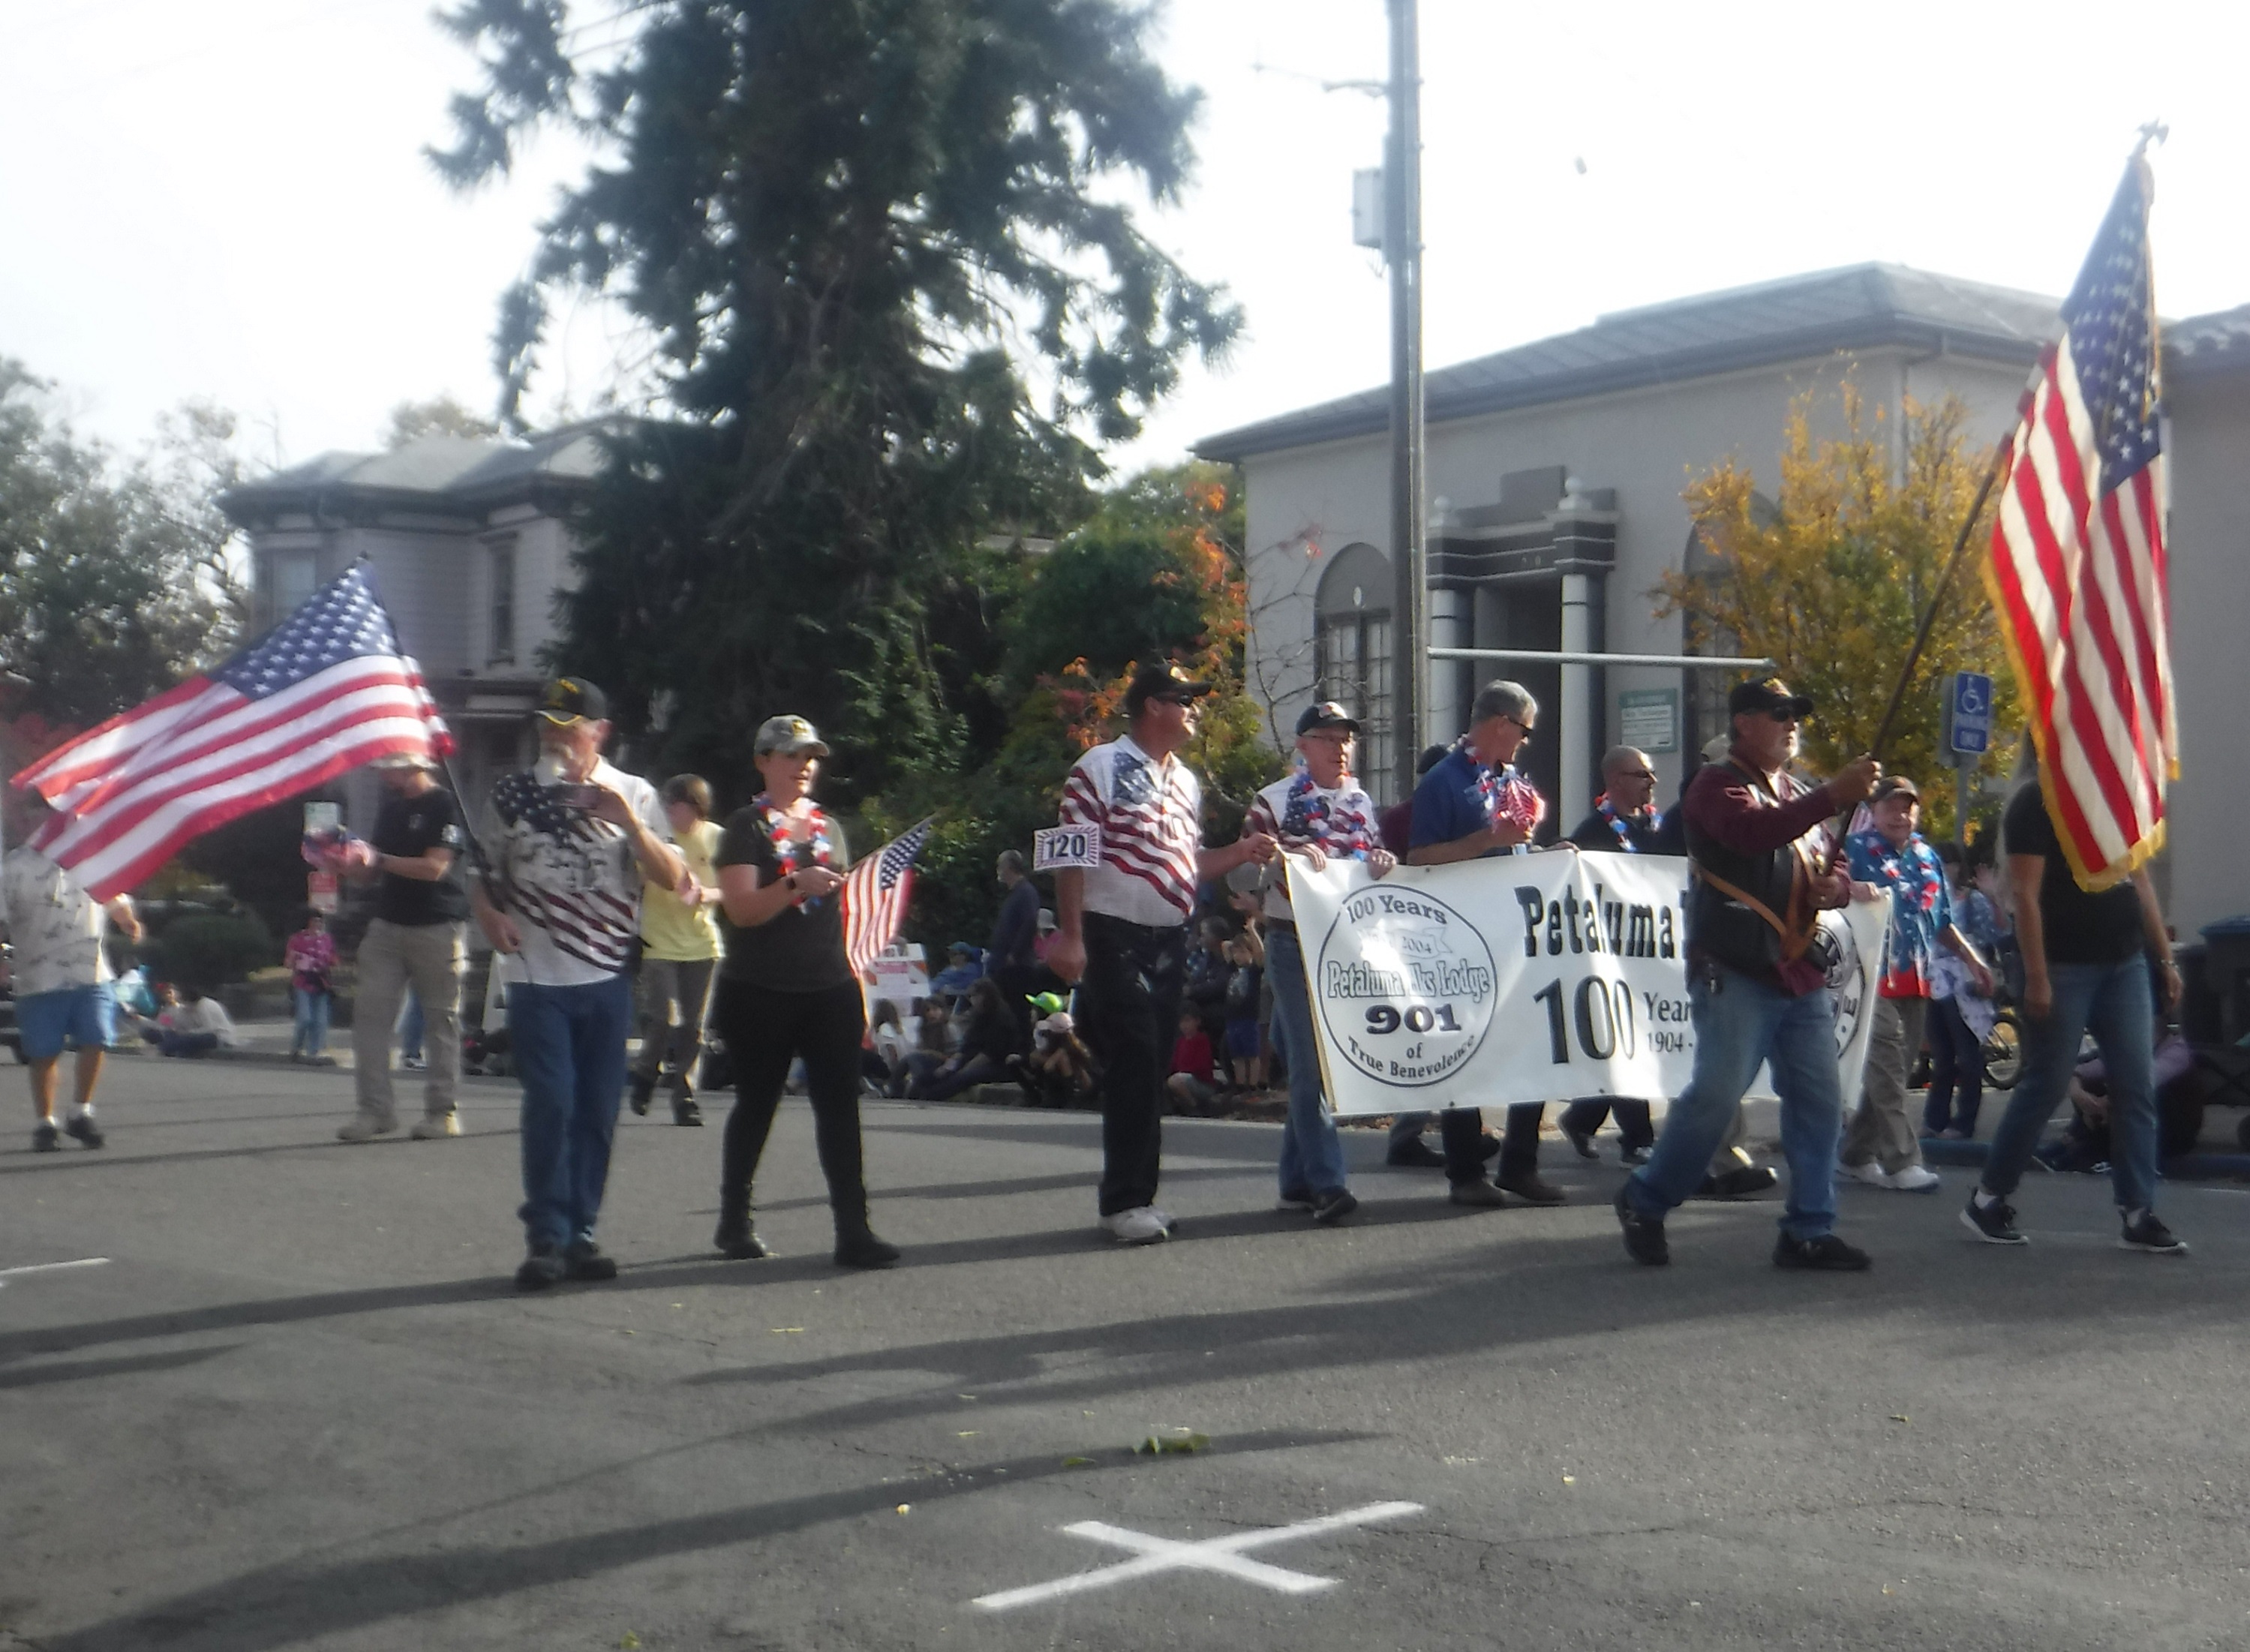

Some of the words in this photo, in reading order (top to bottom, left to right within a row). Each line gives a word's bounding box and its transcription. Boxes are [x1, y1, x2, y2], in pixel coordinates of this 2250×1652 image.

[1047, 834, 1085, 858] 120
[1347, 897, 1375, 924] 100
[1379, 894, 1447, 925] Years
[1514, 882, 1675, 960] Petaluma
[1327, 960, 1405, 999] Petaluma
[1406, 962, 1437, 998] lks
[1437, 958, 1490, 1004] Lodge
[1365, 1003, 1462, 1035] 901
[1533, 975, 1636, 1065] 100
[1643, 992, 1692, 1022] Year
[1348, 1035, 1384, 1072] True
[1389, 1035, 1475, 1078] Benevolence
[1406, 1042, 1424, 1059] of
[1648, 1031, 1684, 1053] 1904
